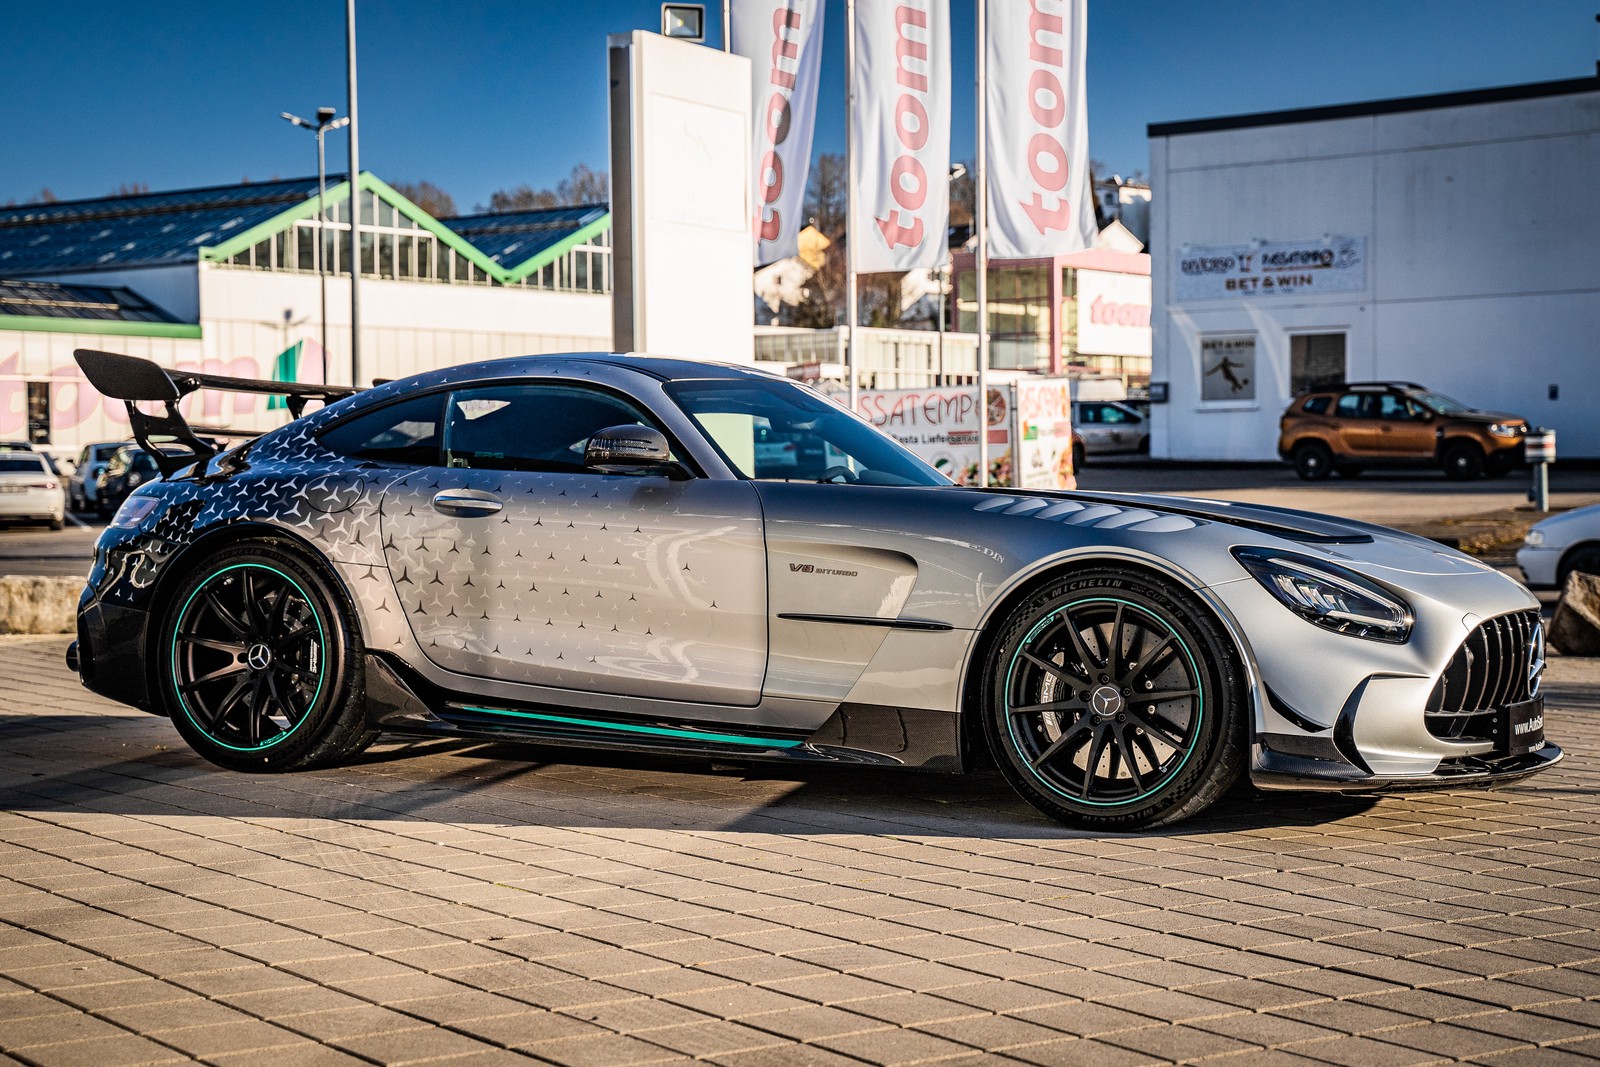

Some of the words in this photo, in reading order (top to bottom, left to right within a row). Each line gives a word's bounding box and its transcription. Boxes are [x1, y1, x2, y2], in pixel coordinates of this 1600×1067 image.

[752, 8, 801, 247] toom
[875, 5, 929, 250] toom
[1019, 0, 1071, 235] toom
[789, 563, 815, 573] V8
[815, 567, 858, 577] BITURBO
[1051, 579, 1123, 598] MICHELIN
[1146, 589, 1168, 604] CUP
[1165, 601, 1175, 610] 2
[1174, 608, 1184, 618] R
